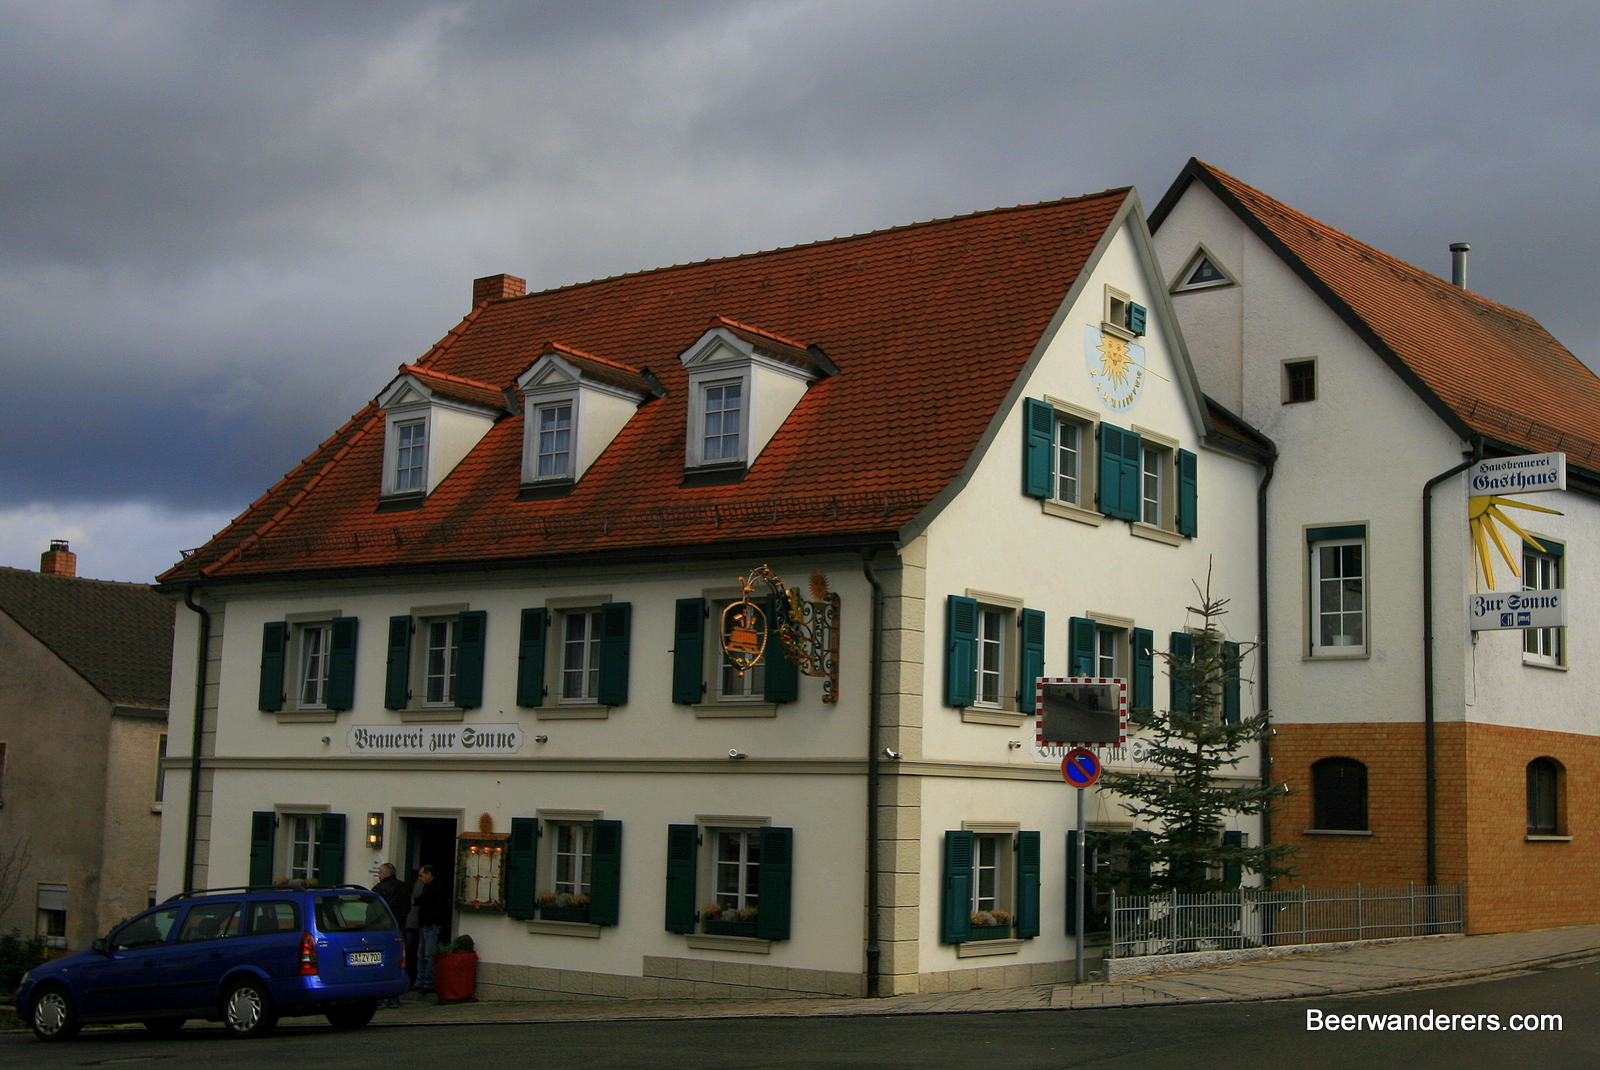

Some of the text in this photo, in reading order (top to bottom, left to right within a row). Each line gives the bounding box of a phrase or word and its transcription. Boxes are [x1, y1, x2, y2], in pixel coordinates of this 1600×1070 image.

[1479, 456, 1550, 473] Hausbrauerei
[1473, 468, 1558, 490] Gasthaus
[1474, 594, 1558, 617] Zur Sonne
[354, 727, 516, 752] Brauerei zur Sonne
